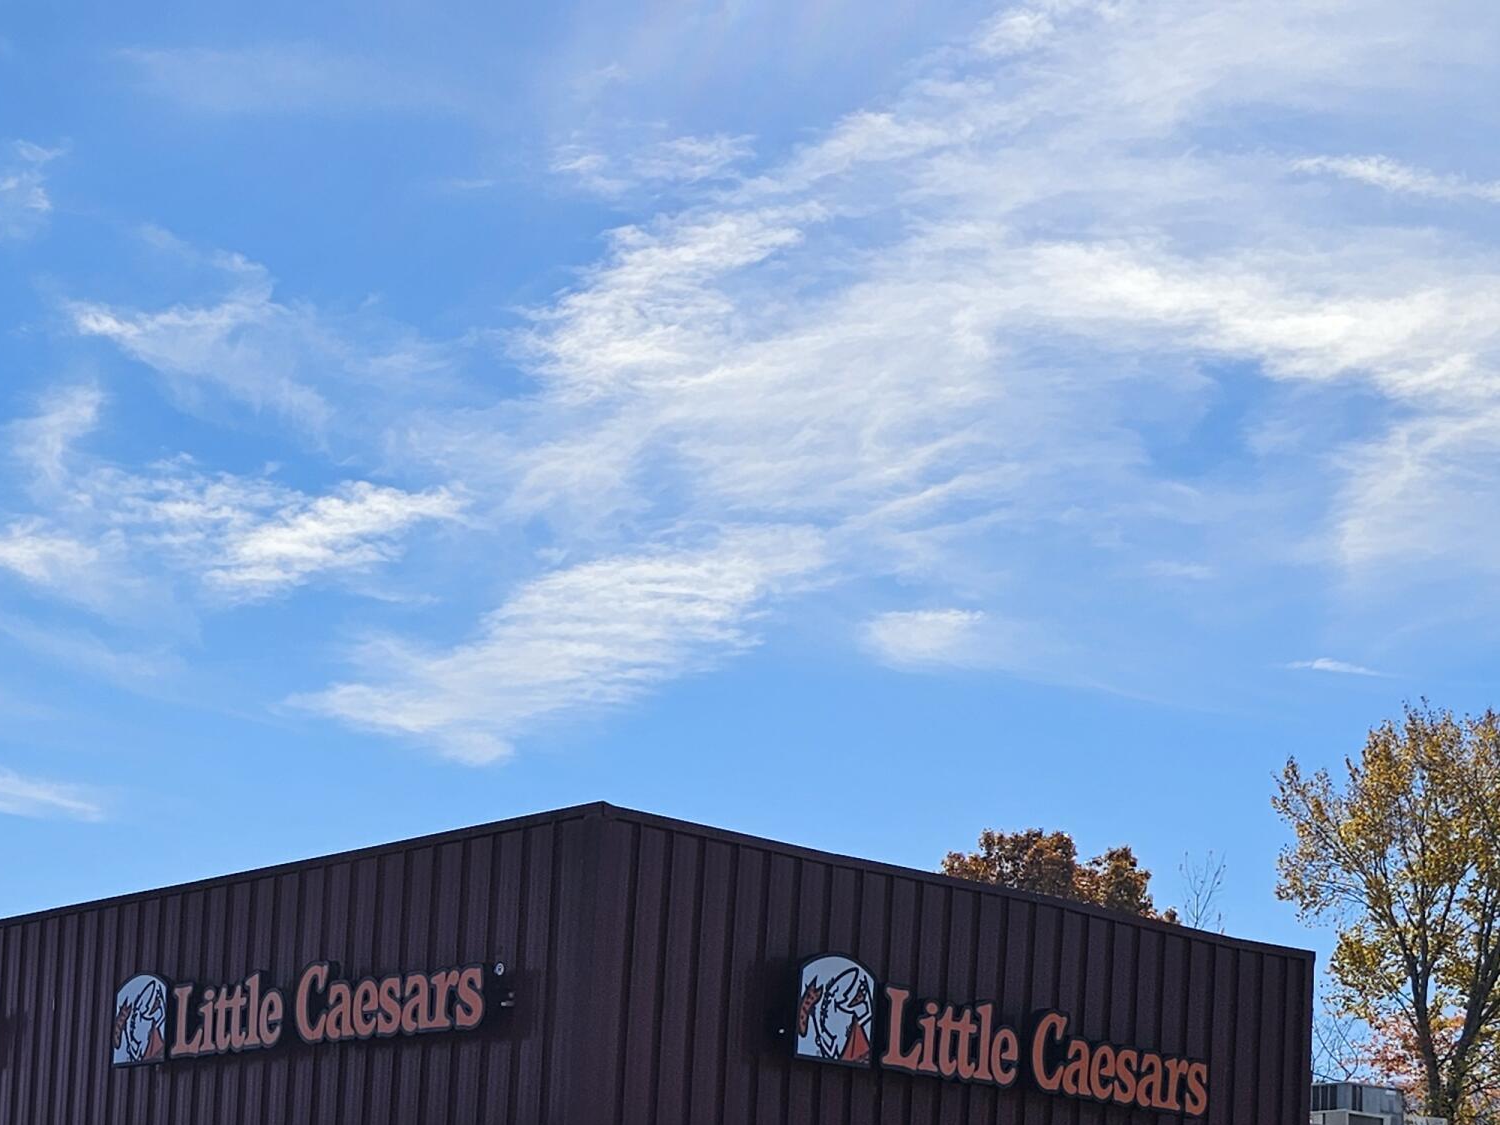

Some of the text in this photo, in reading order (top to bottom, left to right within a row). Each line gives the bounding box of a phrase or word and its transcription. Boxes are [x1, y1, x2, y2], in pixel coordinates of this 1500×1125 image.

[169, 961, 485, 1058] Little Caesars
[881, 986, 1209, 1117] Little Caesars
